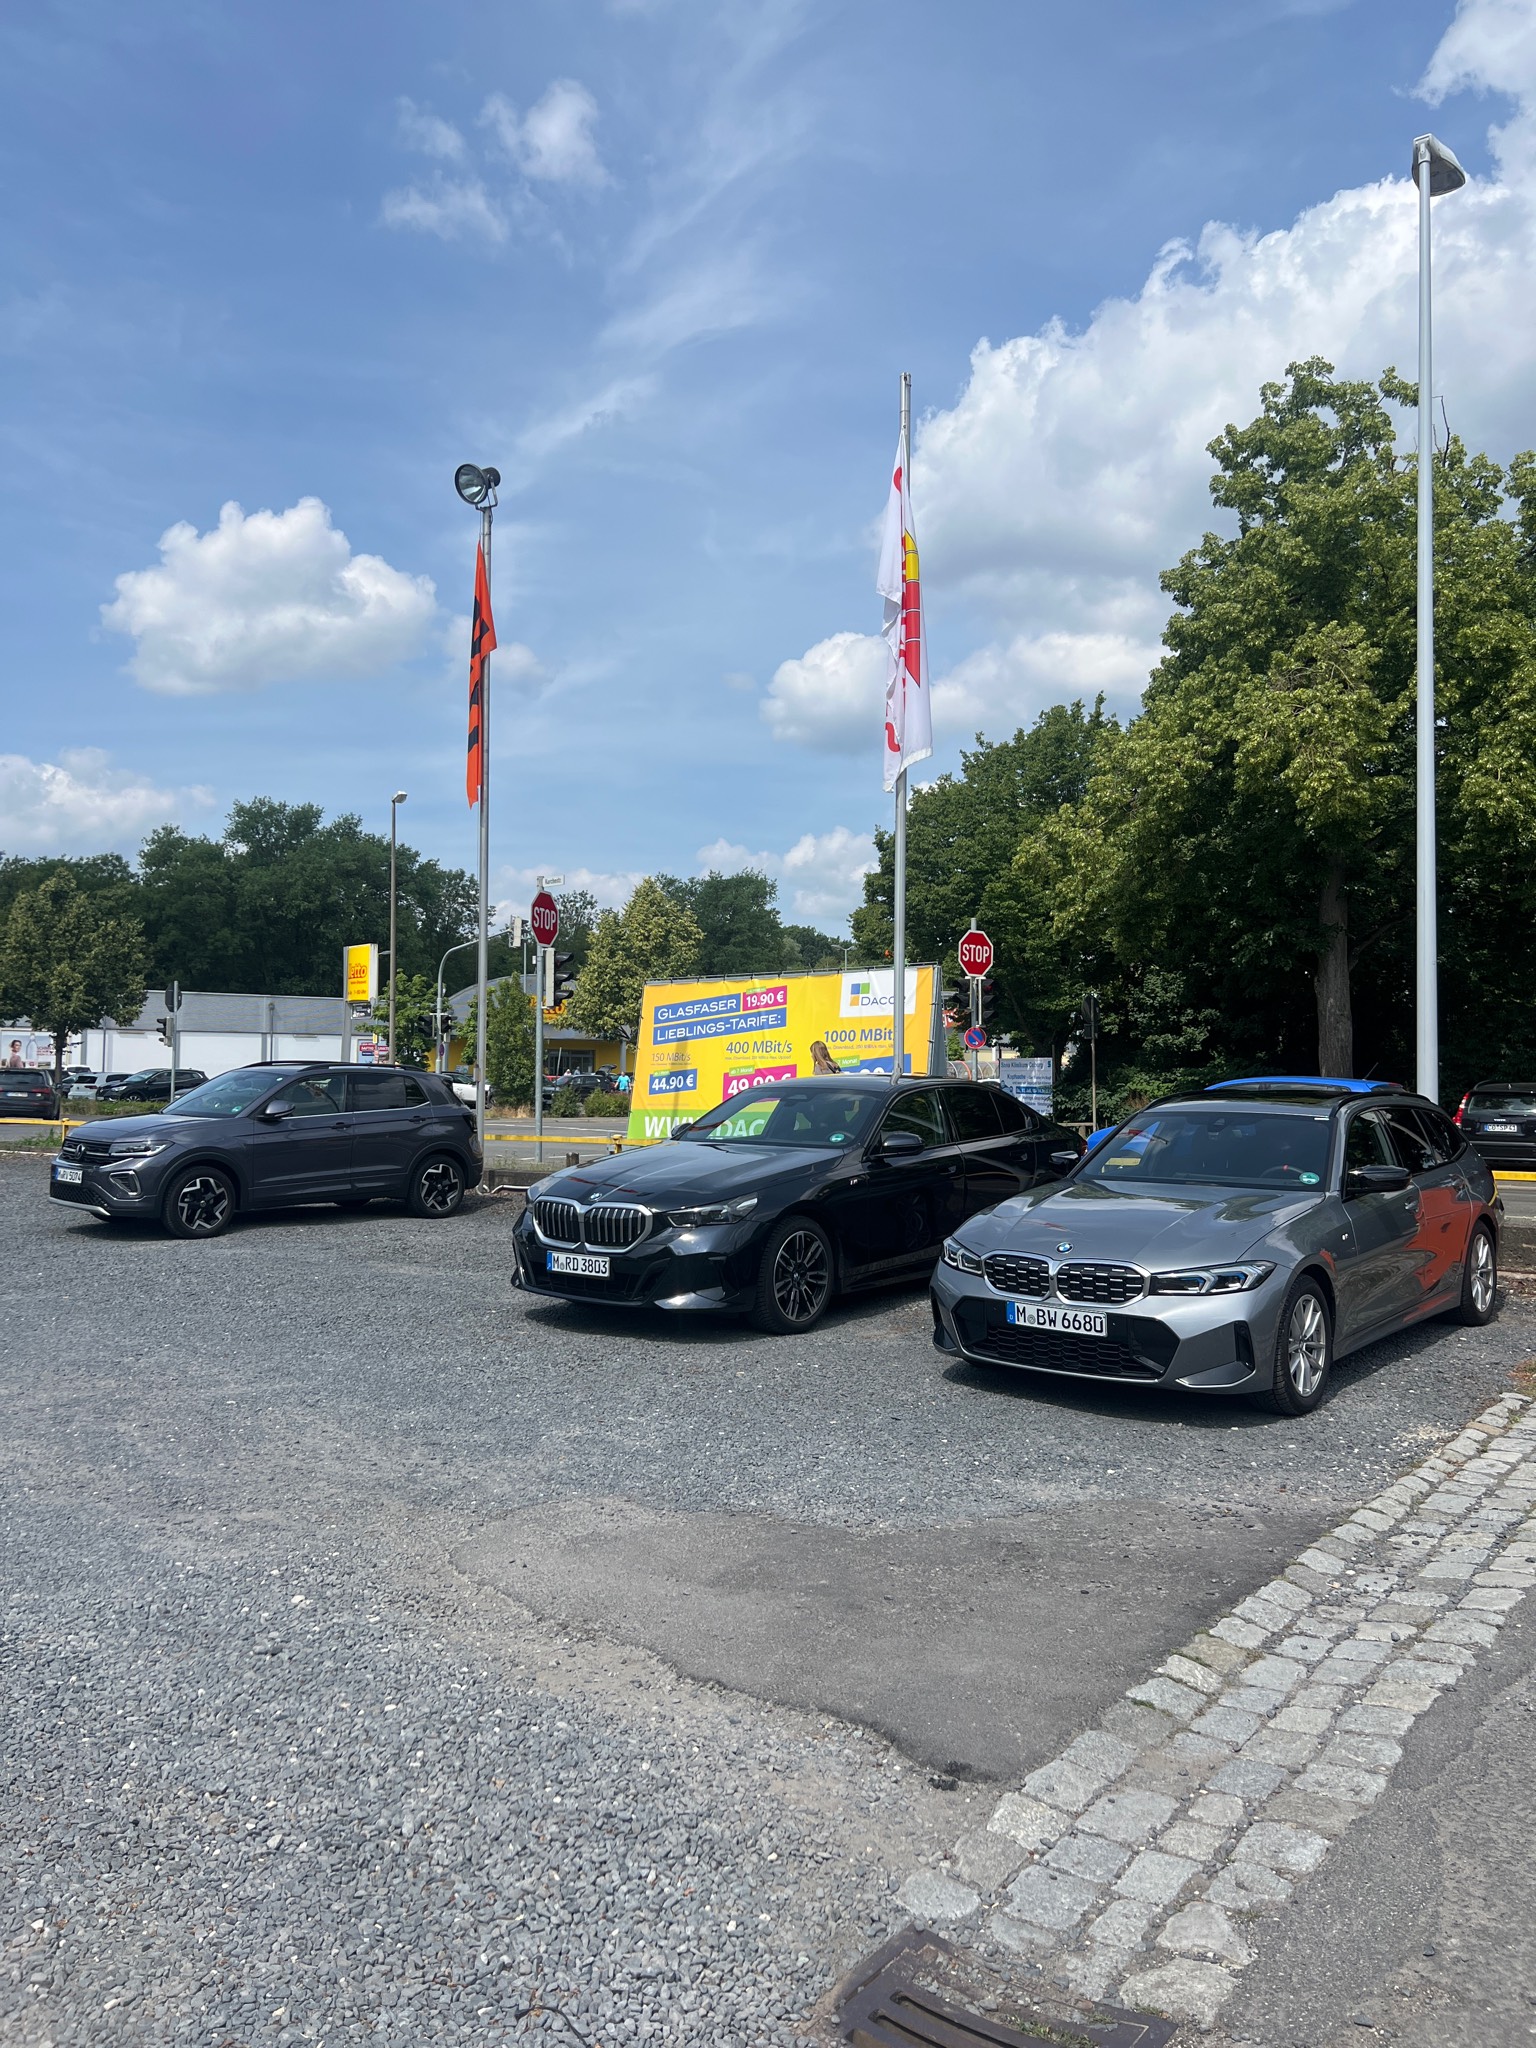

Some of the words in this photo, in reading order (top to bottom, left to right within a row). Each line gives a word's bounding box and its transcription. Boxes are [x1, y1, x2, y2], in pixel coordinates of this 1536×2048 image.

[533, 906, 557, 931] STOP
[962, 943, 990, 963] STOP
[746, 994, 775, 1007] 19.90
[776, 990, 785, 1002] €
[657, 999, 737, 1020] GLASFASER
[824, 1029, 857, 1043] 1000
[860, 1028, 895, 1042] MBit
[726, 1041, 750, 1054] 400
[753, 1040, 793, 1054] MBit/s
[652, 1052, 665, 1062] 150
[667, 1052, 691, 1062] MBit/s
[651, 1077, 684, 1091] 44.90
[685, 1074, 694, 1087] €
[553, 1255, 559, 1269] M
[565, 1256, 579, 1271] RD
[581, 1258, 608, 1274] 3803
[1016, 1305, 1026, 1323] M
[1037, 1308, 1057, 1328] BW
[1062, 1312, 1105, 1334] 6680
